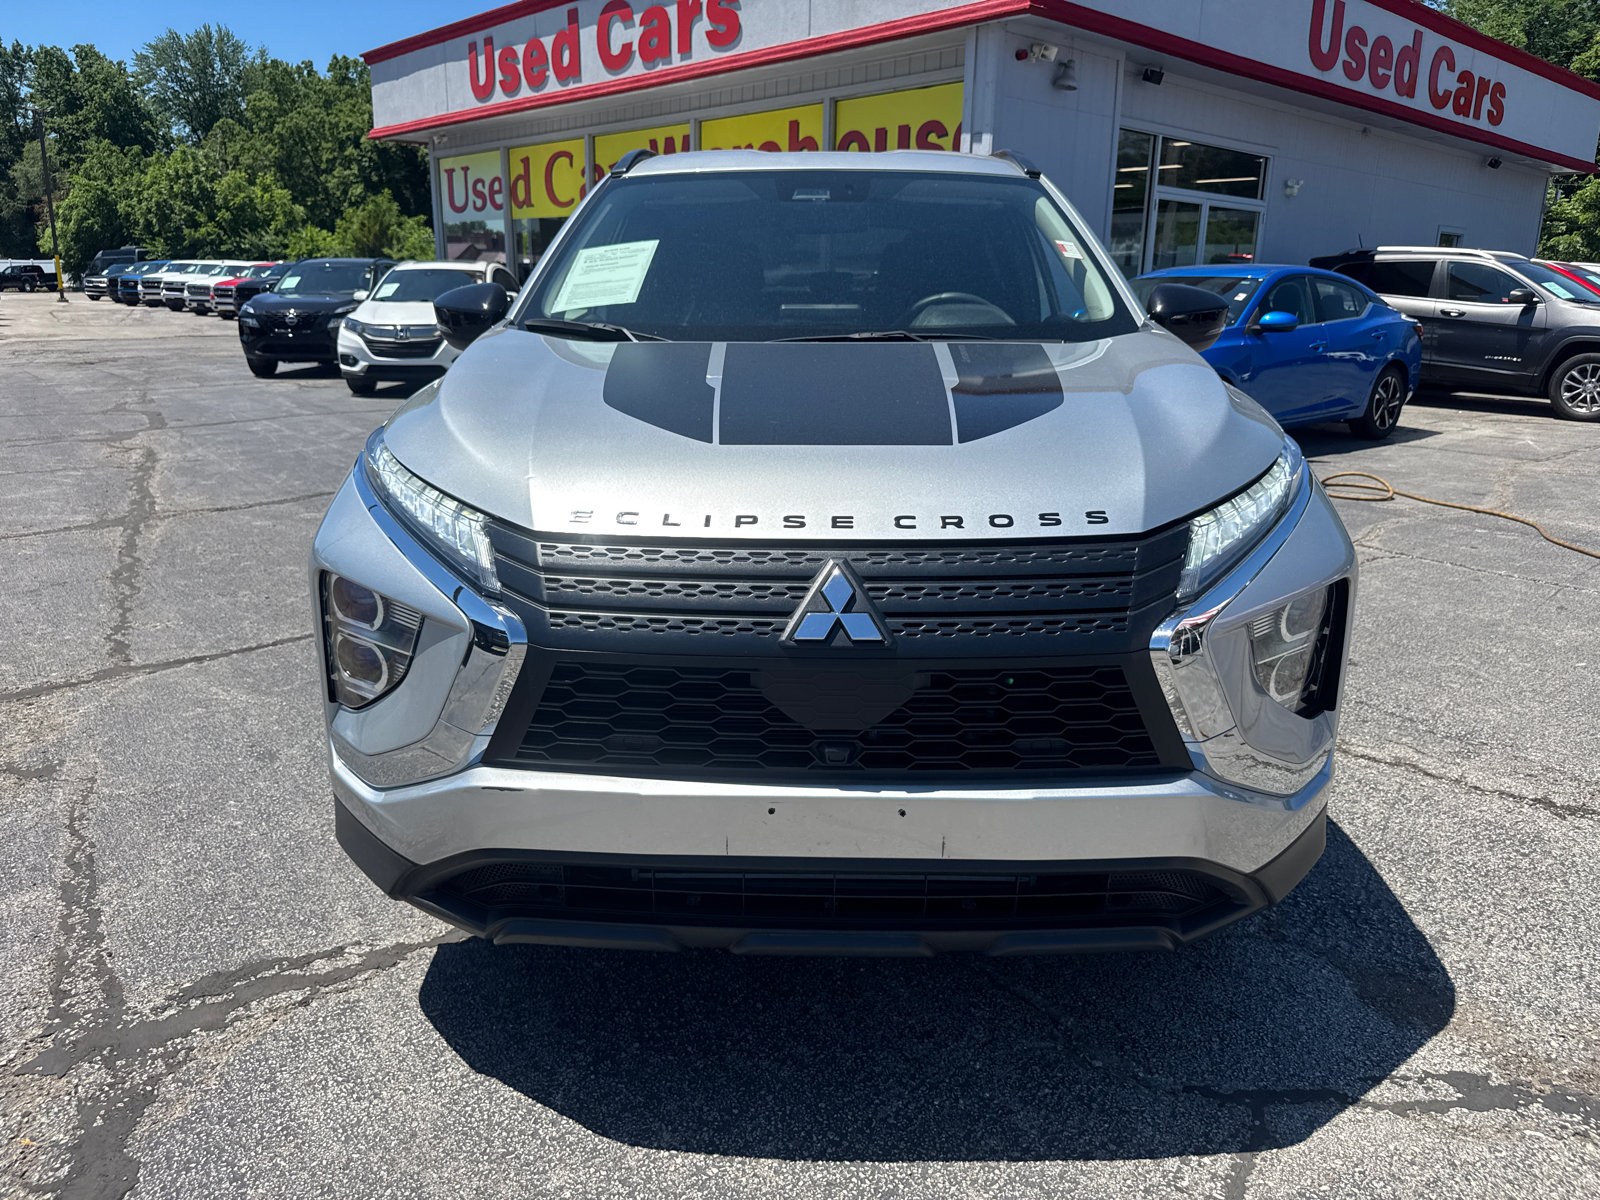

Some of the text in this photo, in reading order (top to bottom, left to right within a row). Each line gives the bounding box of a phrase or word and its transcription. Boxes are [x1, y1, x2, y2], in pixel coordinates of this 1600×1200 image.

[469, 0, 741, 99] Used Cars
[1309, 0, 1506, 126] Used Cars
[444, 150, 617, 213] Used Ca
[569, 510, 1109, 529] ECLIPSE CROSS
